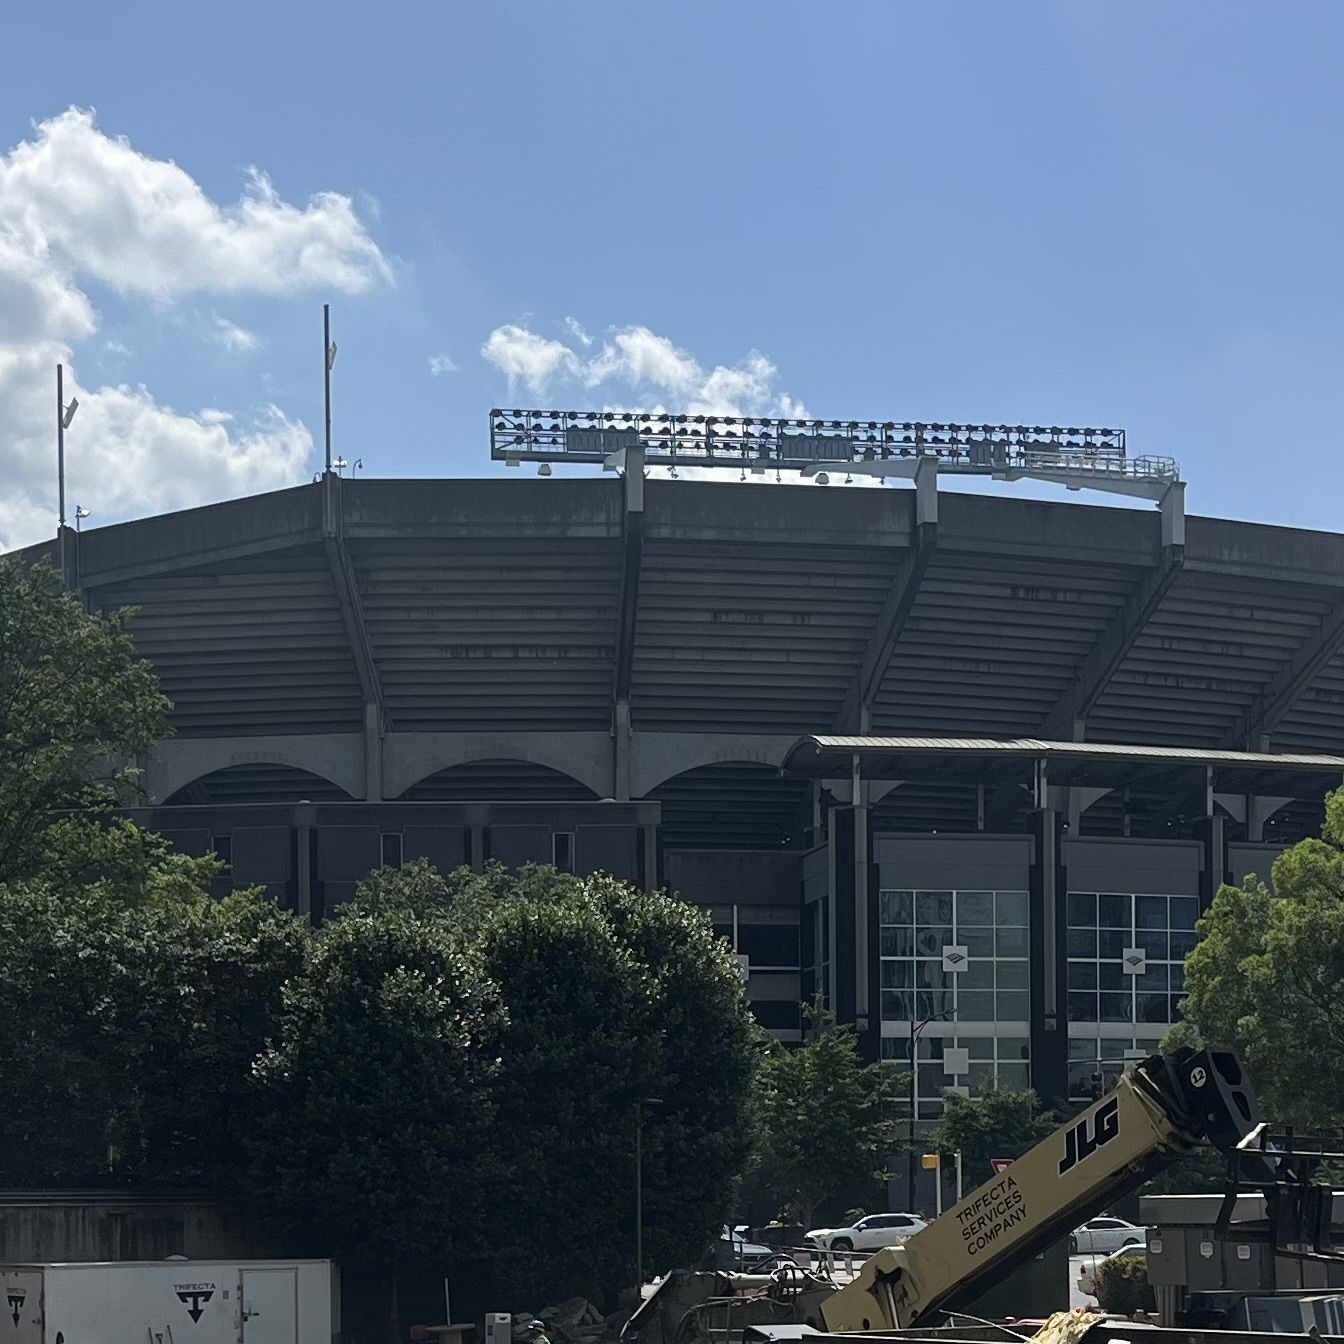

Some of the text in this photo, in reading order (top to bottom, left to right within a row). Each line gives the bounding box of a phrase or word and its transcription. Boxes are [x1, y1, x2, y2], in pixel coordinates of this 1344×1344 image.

[1191, 1069, 1206, 1084] 12
[1057, 1095, 1121, 1179] JLG
[956, 1176, 1017, 1225] TRIFECTA
[961, 1190, 1023, 1241] SERVICES
[967, 1204, 1027, 1255] COMPANY
[173, 1282, 216, 1292] TRIFECTA
